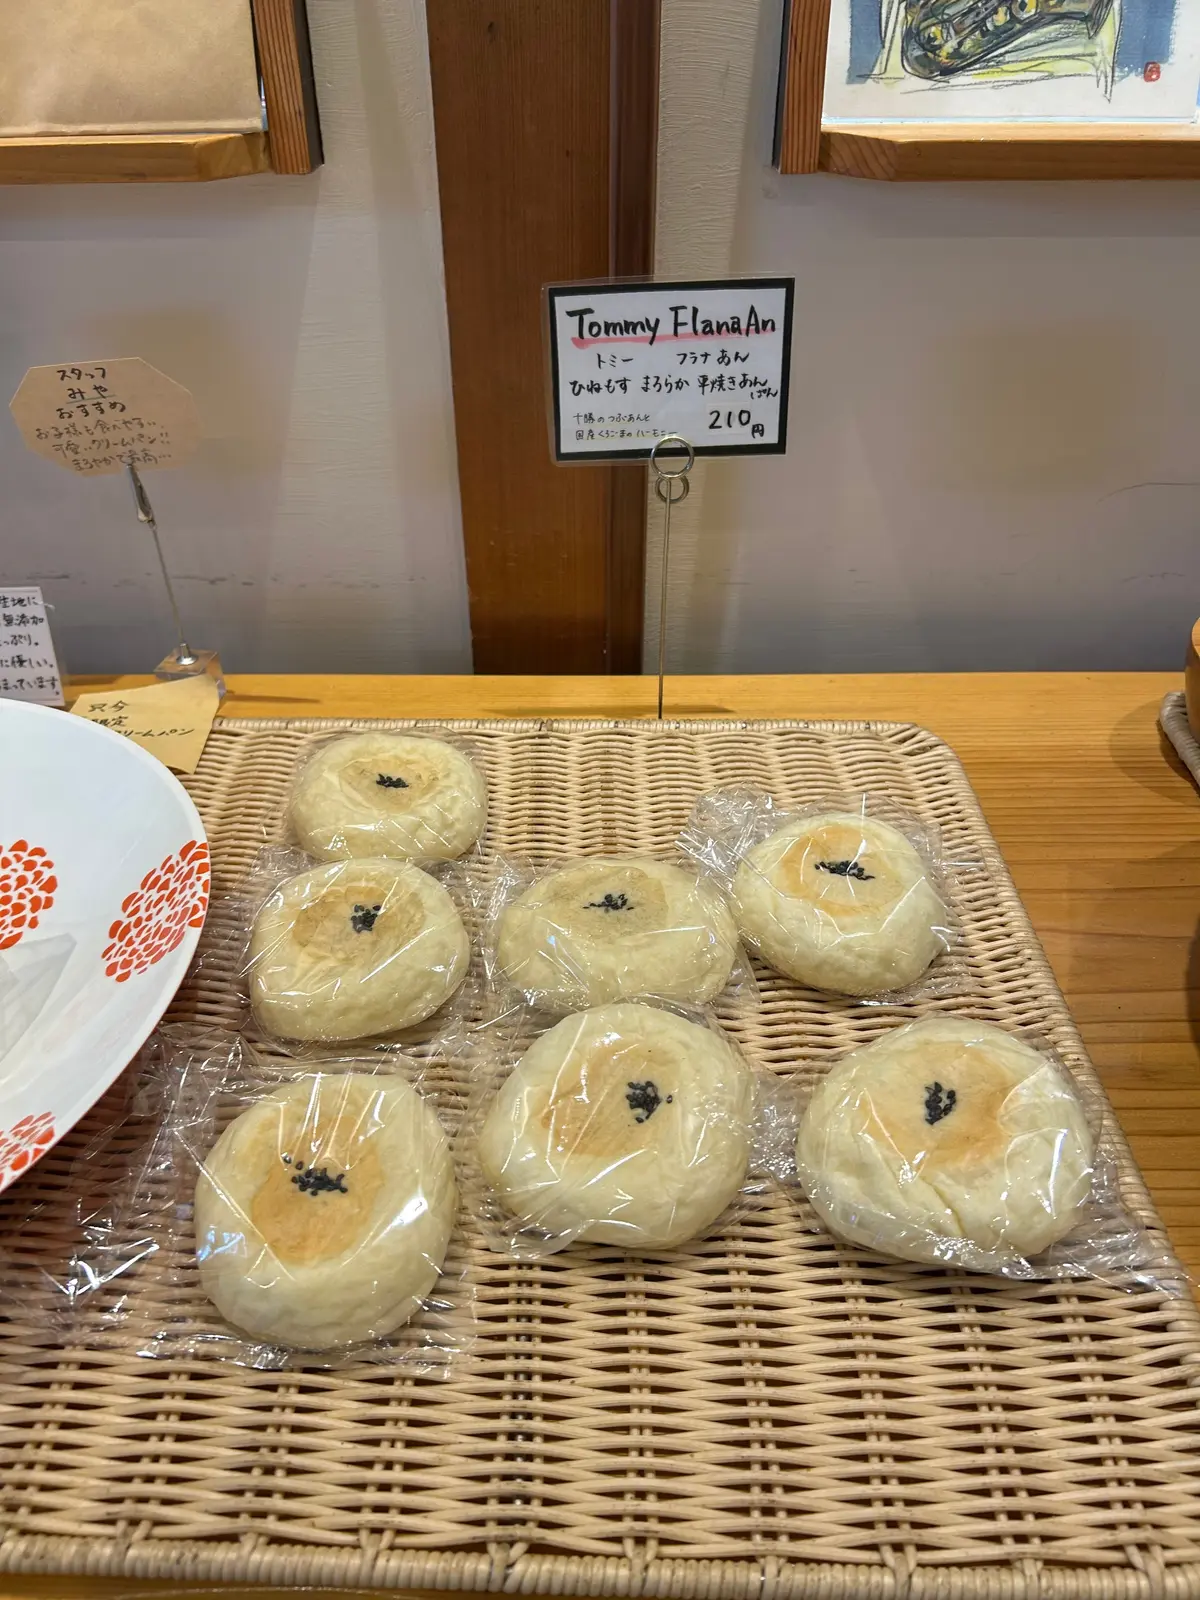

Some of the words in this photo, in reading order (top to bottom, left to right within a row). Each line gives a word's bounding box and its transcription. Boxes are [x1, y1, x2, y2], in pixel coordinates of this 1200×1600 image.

[565, 307, 660, 346] Tommy
[669, 304, 776, 337] FlanaAn
[596, 353, 634, 369] トミー
[56, 367, 107, 381] スタッフ
[67, 384, 109, 400] みや
[569, 377, 631, 396] ひねもす
[641, 375, 690, 394] まろらか
[55, 401, 127, 419] おすすめ
[0, 613, 45, 627] 無添加
[0, 634, 39, 647] っぷり。
